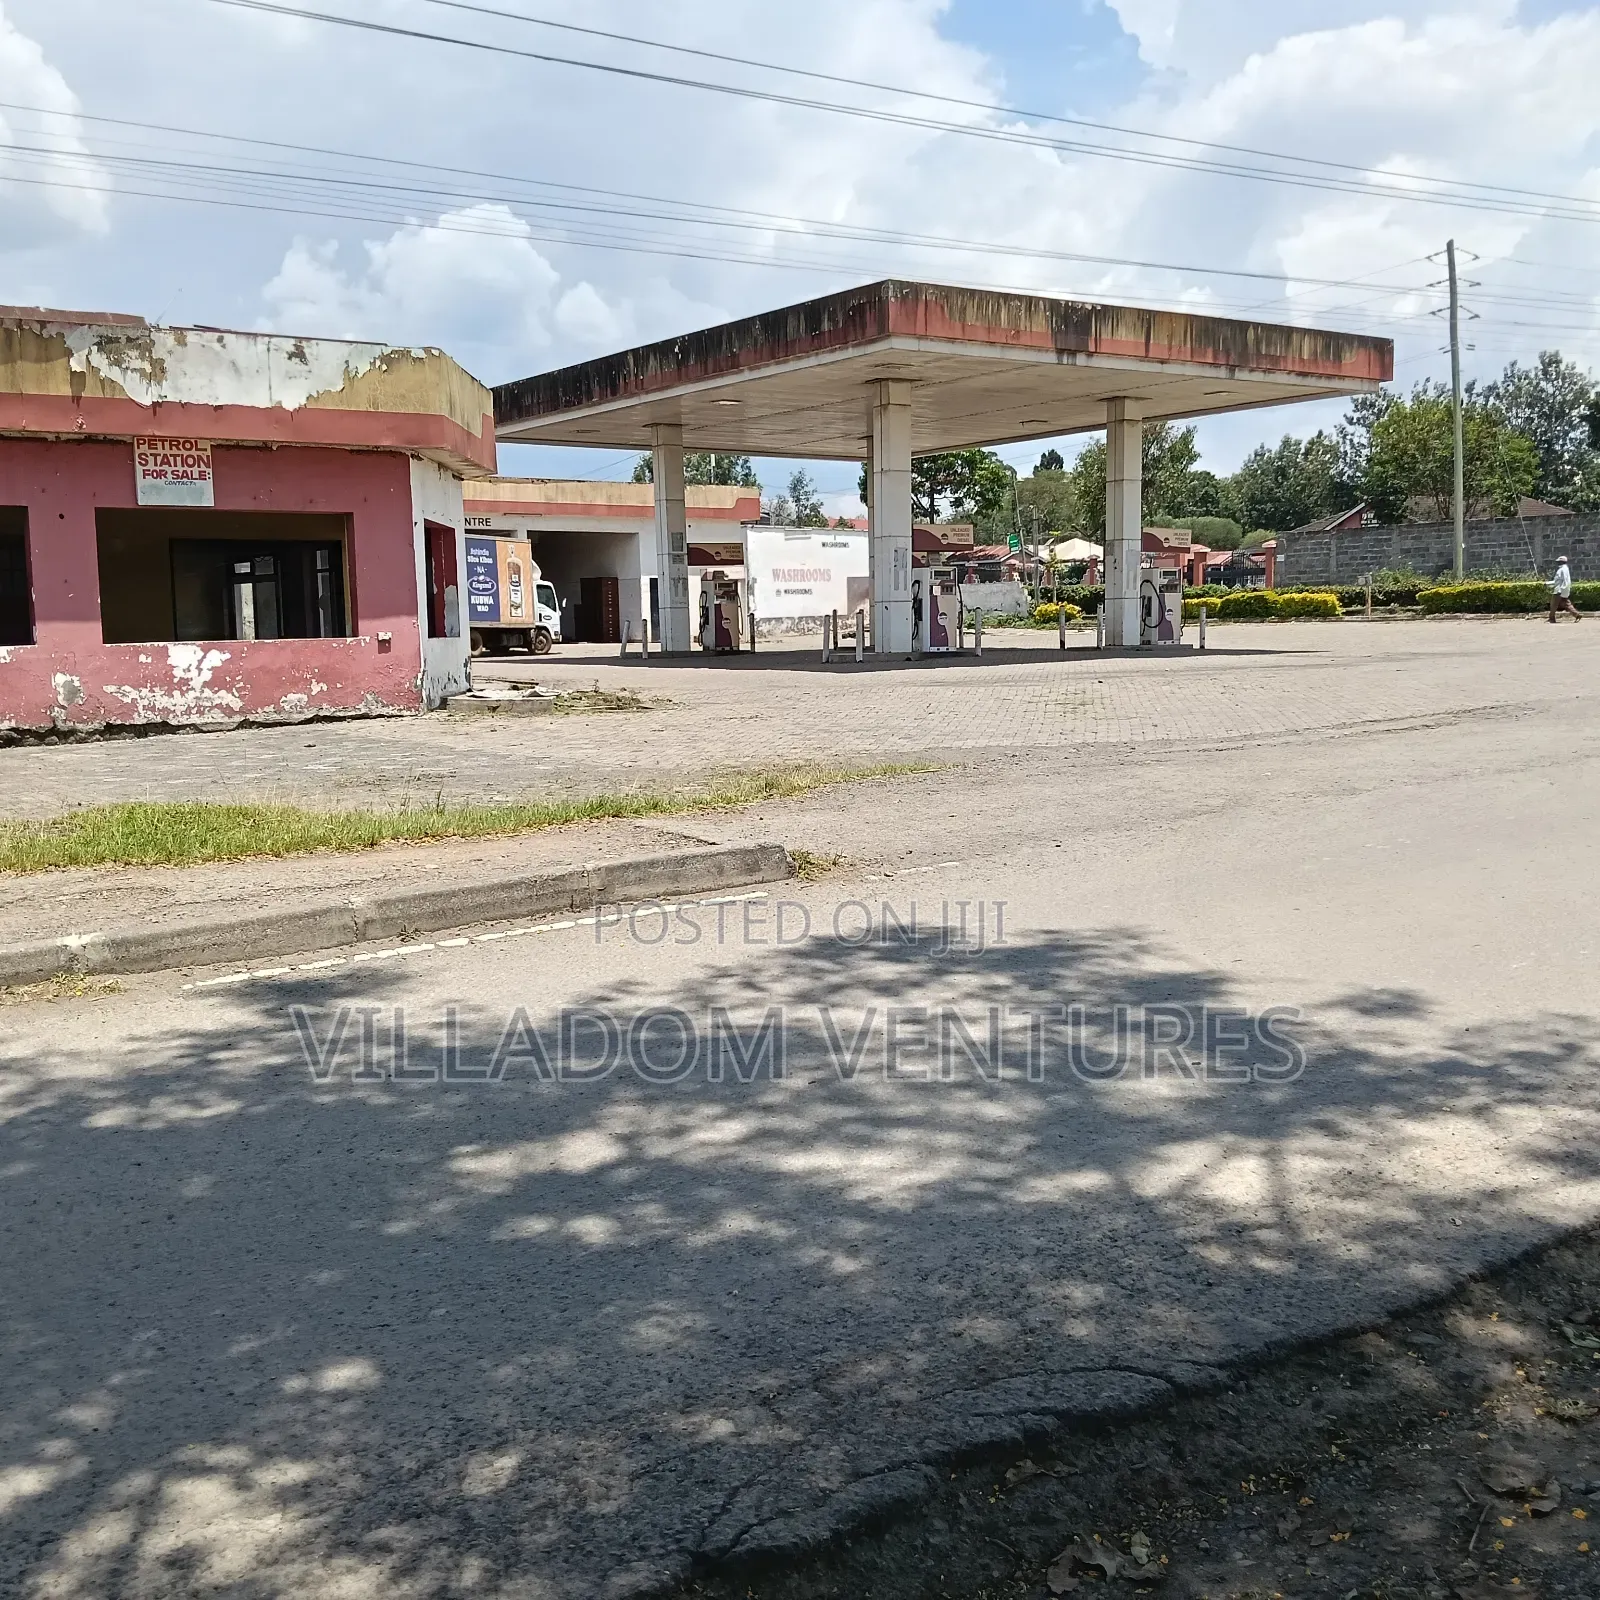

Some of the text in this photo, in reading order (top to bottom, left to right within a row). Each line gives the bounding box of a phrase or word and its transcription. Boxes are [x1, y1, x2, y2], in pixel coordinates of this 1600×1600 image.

[136, 438, 207, 452] PETROL
[137, 453, 211, 468] STATION
[142, 469, 211, 480] FOR SALE:
[772, 568, 832, 582] WASHROOMS
